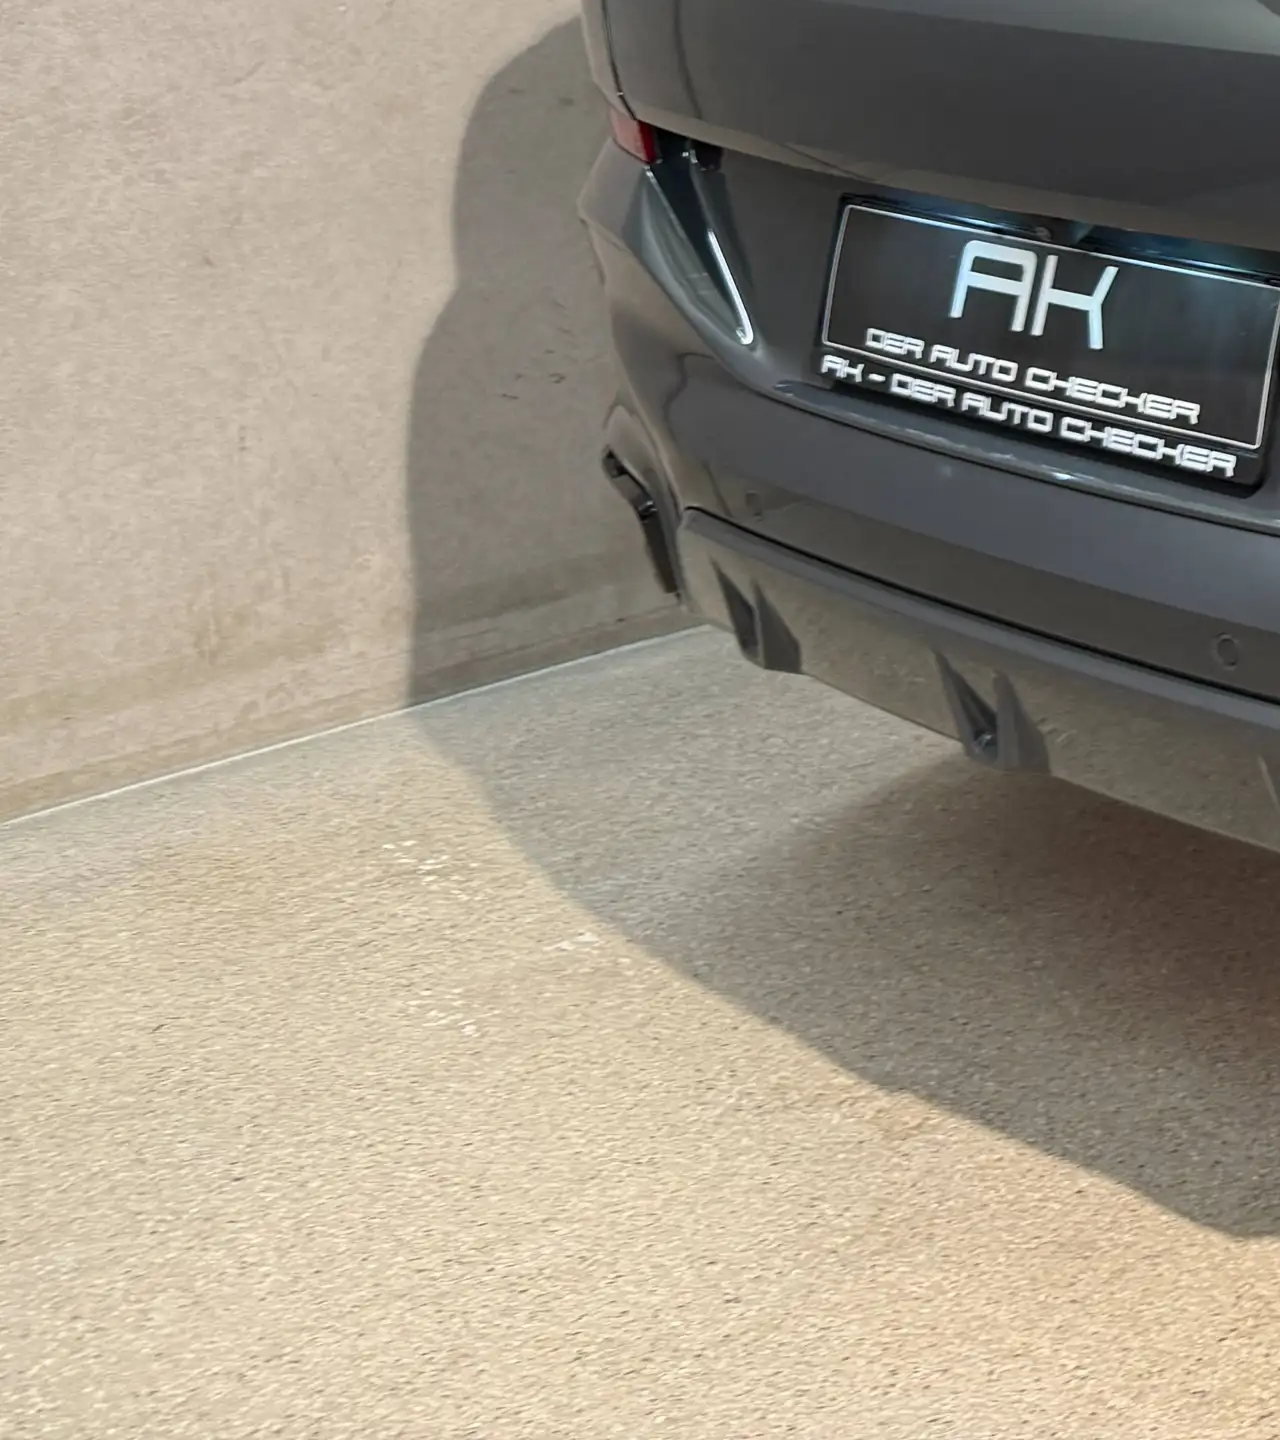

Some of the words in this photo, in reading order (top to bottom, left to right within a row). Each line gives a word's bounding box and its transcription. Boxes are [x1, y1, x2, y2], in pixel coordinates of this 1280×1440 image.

[949, 239, 1120, 351] AK
[821, 354, 865, 383] AK
[890, 372, 957, 408] DER
[961, 391, 1054, 434] AUTO
[1060, 415, 1238, 478] CHECKER
[864, 327, 925, 360] DER
[928, 344, 1019, 383] AUTO
[1024, 366, 1201, 425] CHECKER
